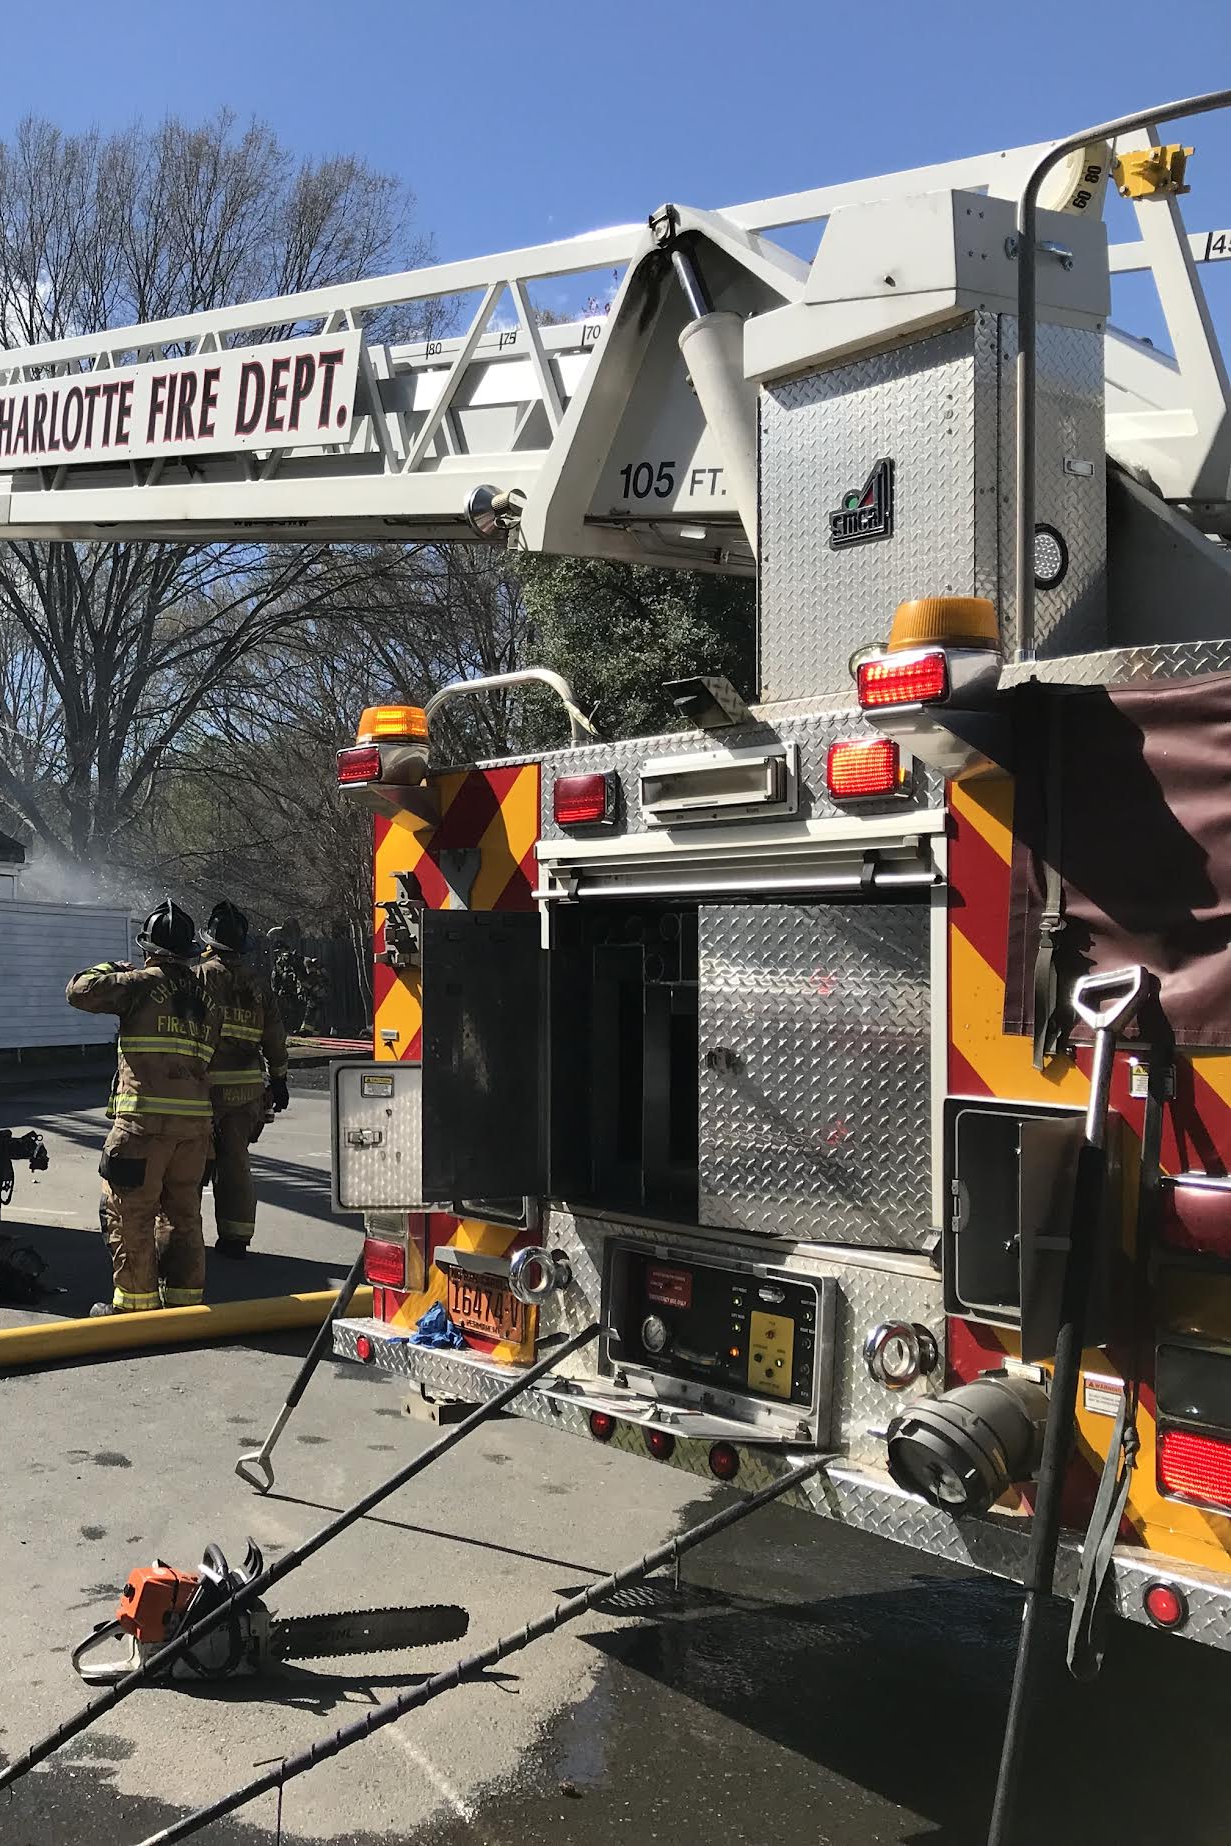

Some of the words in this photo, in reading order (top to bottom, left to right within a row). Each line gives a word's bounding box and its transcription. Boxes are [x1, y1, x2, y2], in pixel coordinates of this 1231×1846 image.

[1085, 166, 1102, 183] 80
[1072, 191, 1092, 208] 60
[1212, 234, 1231, 254] 4
[504, 332, 516, 345] 75
[586, 325, 601, 341] 70
[428, 342, 442, 355] 80
[146, 368, 221, 445] FIRE
[234, 348, 348, 438] DEPT.
[620, 461, 675, 499] 105
[689, 469, 727, 496] FT.
